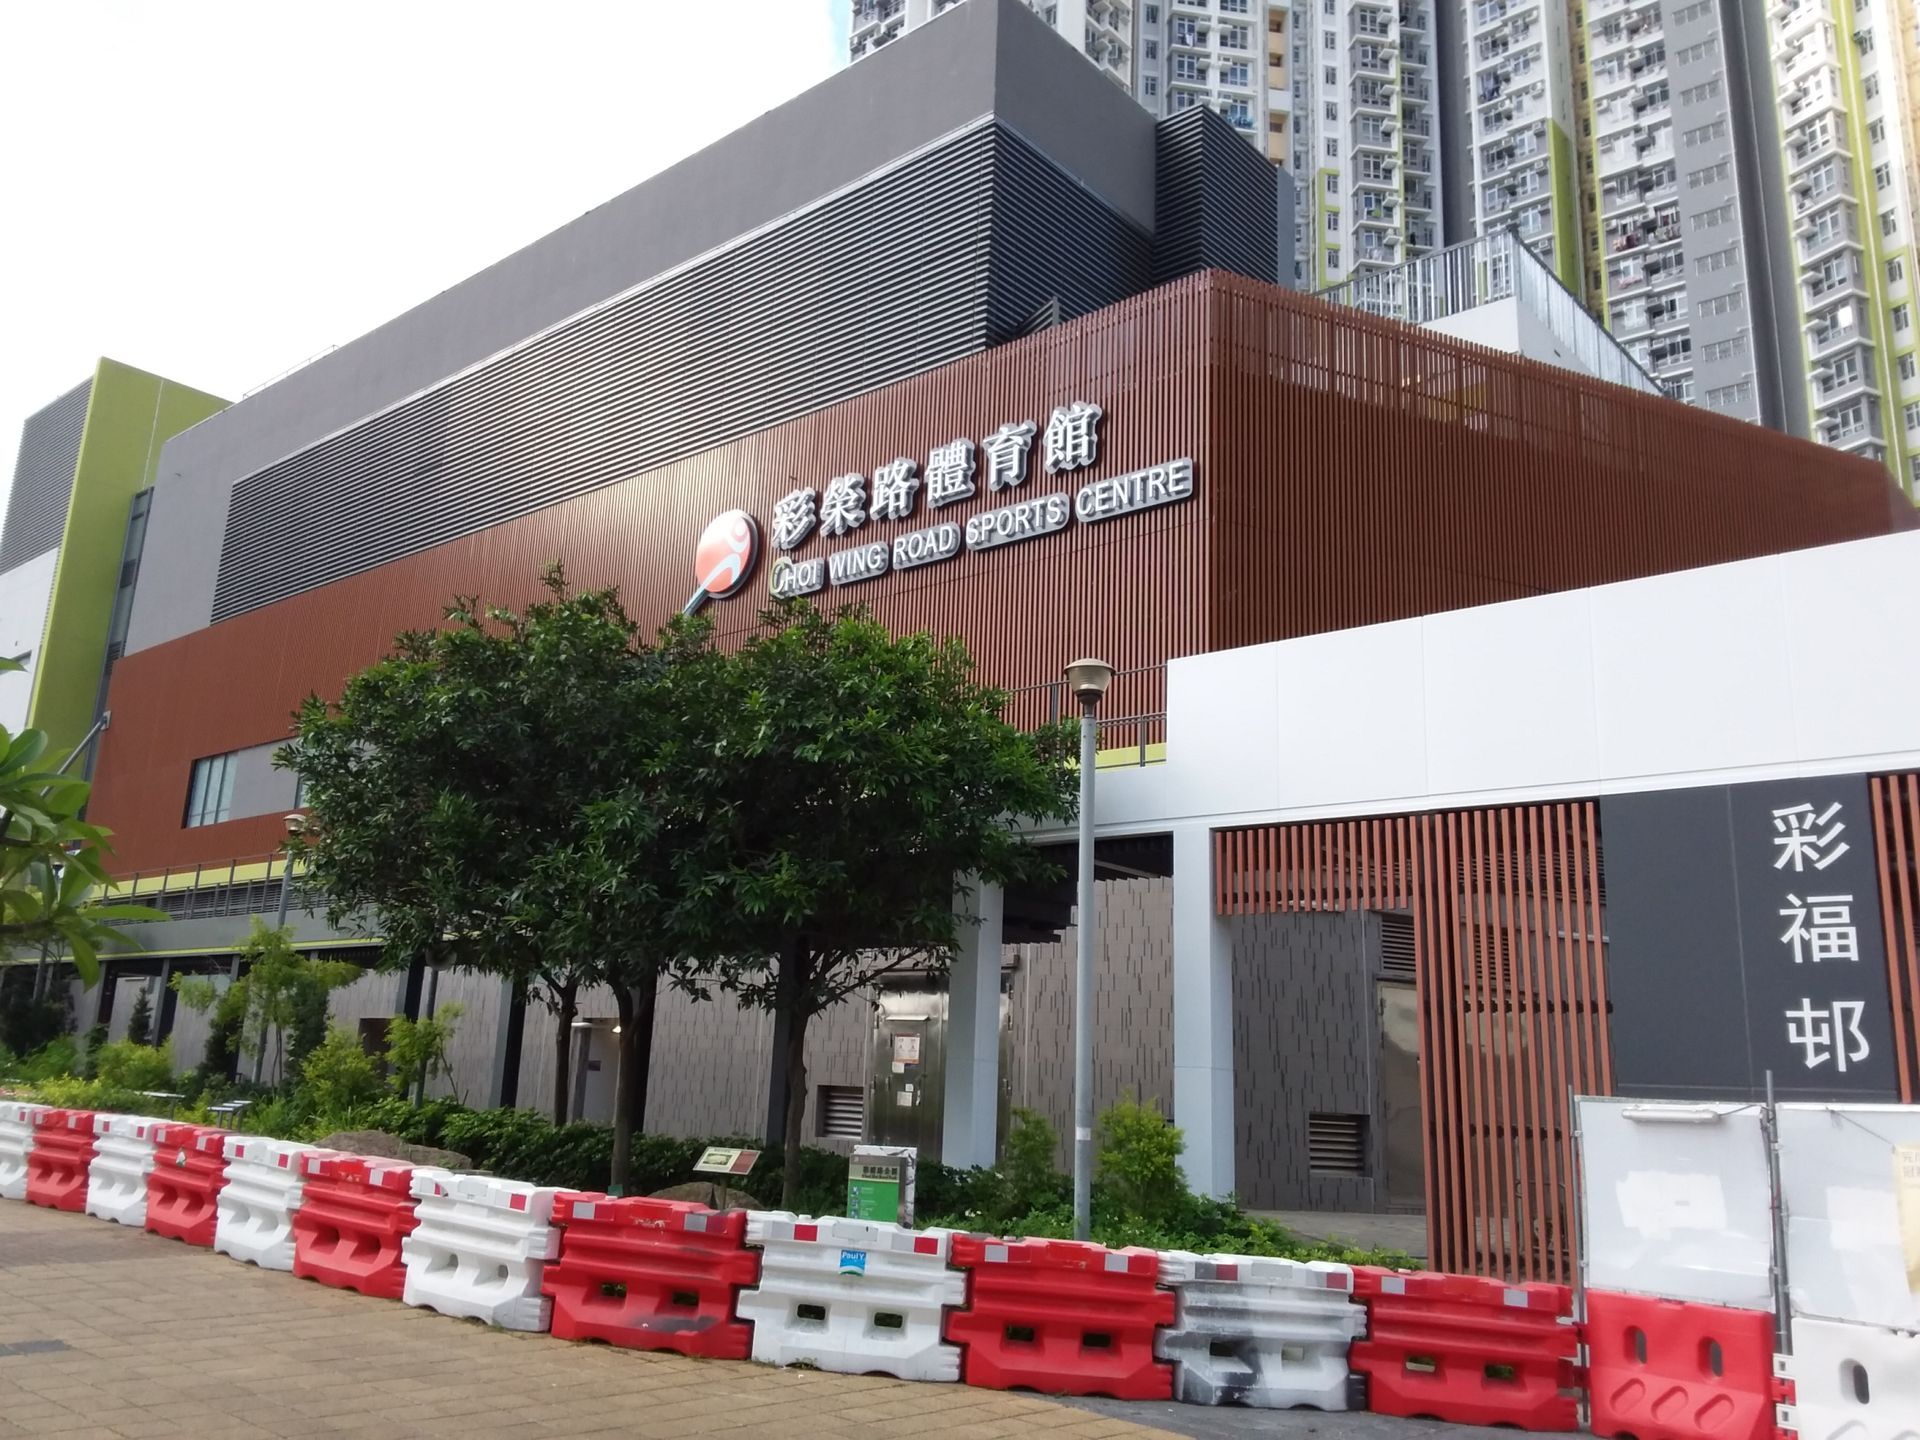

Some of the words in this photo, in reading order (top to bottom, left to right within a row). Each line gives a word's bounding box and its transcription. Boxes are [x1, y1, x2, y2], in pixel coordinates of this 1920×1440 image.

[771, 559, 819, 594] CHOI
[829, 544, 882, 580] WING
[893, 525, 954, 563] ROAD
[965, 496, 1063, 545] SPORTS
[1075, 460, 1186, 516] CENTRE
[772, 401, 1101, 549] 彩榮路體育館
[1771, 801, 1870, 1073] 彩福邨
